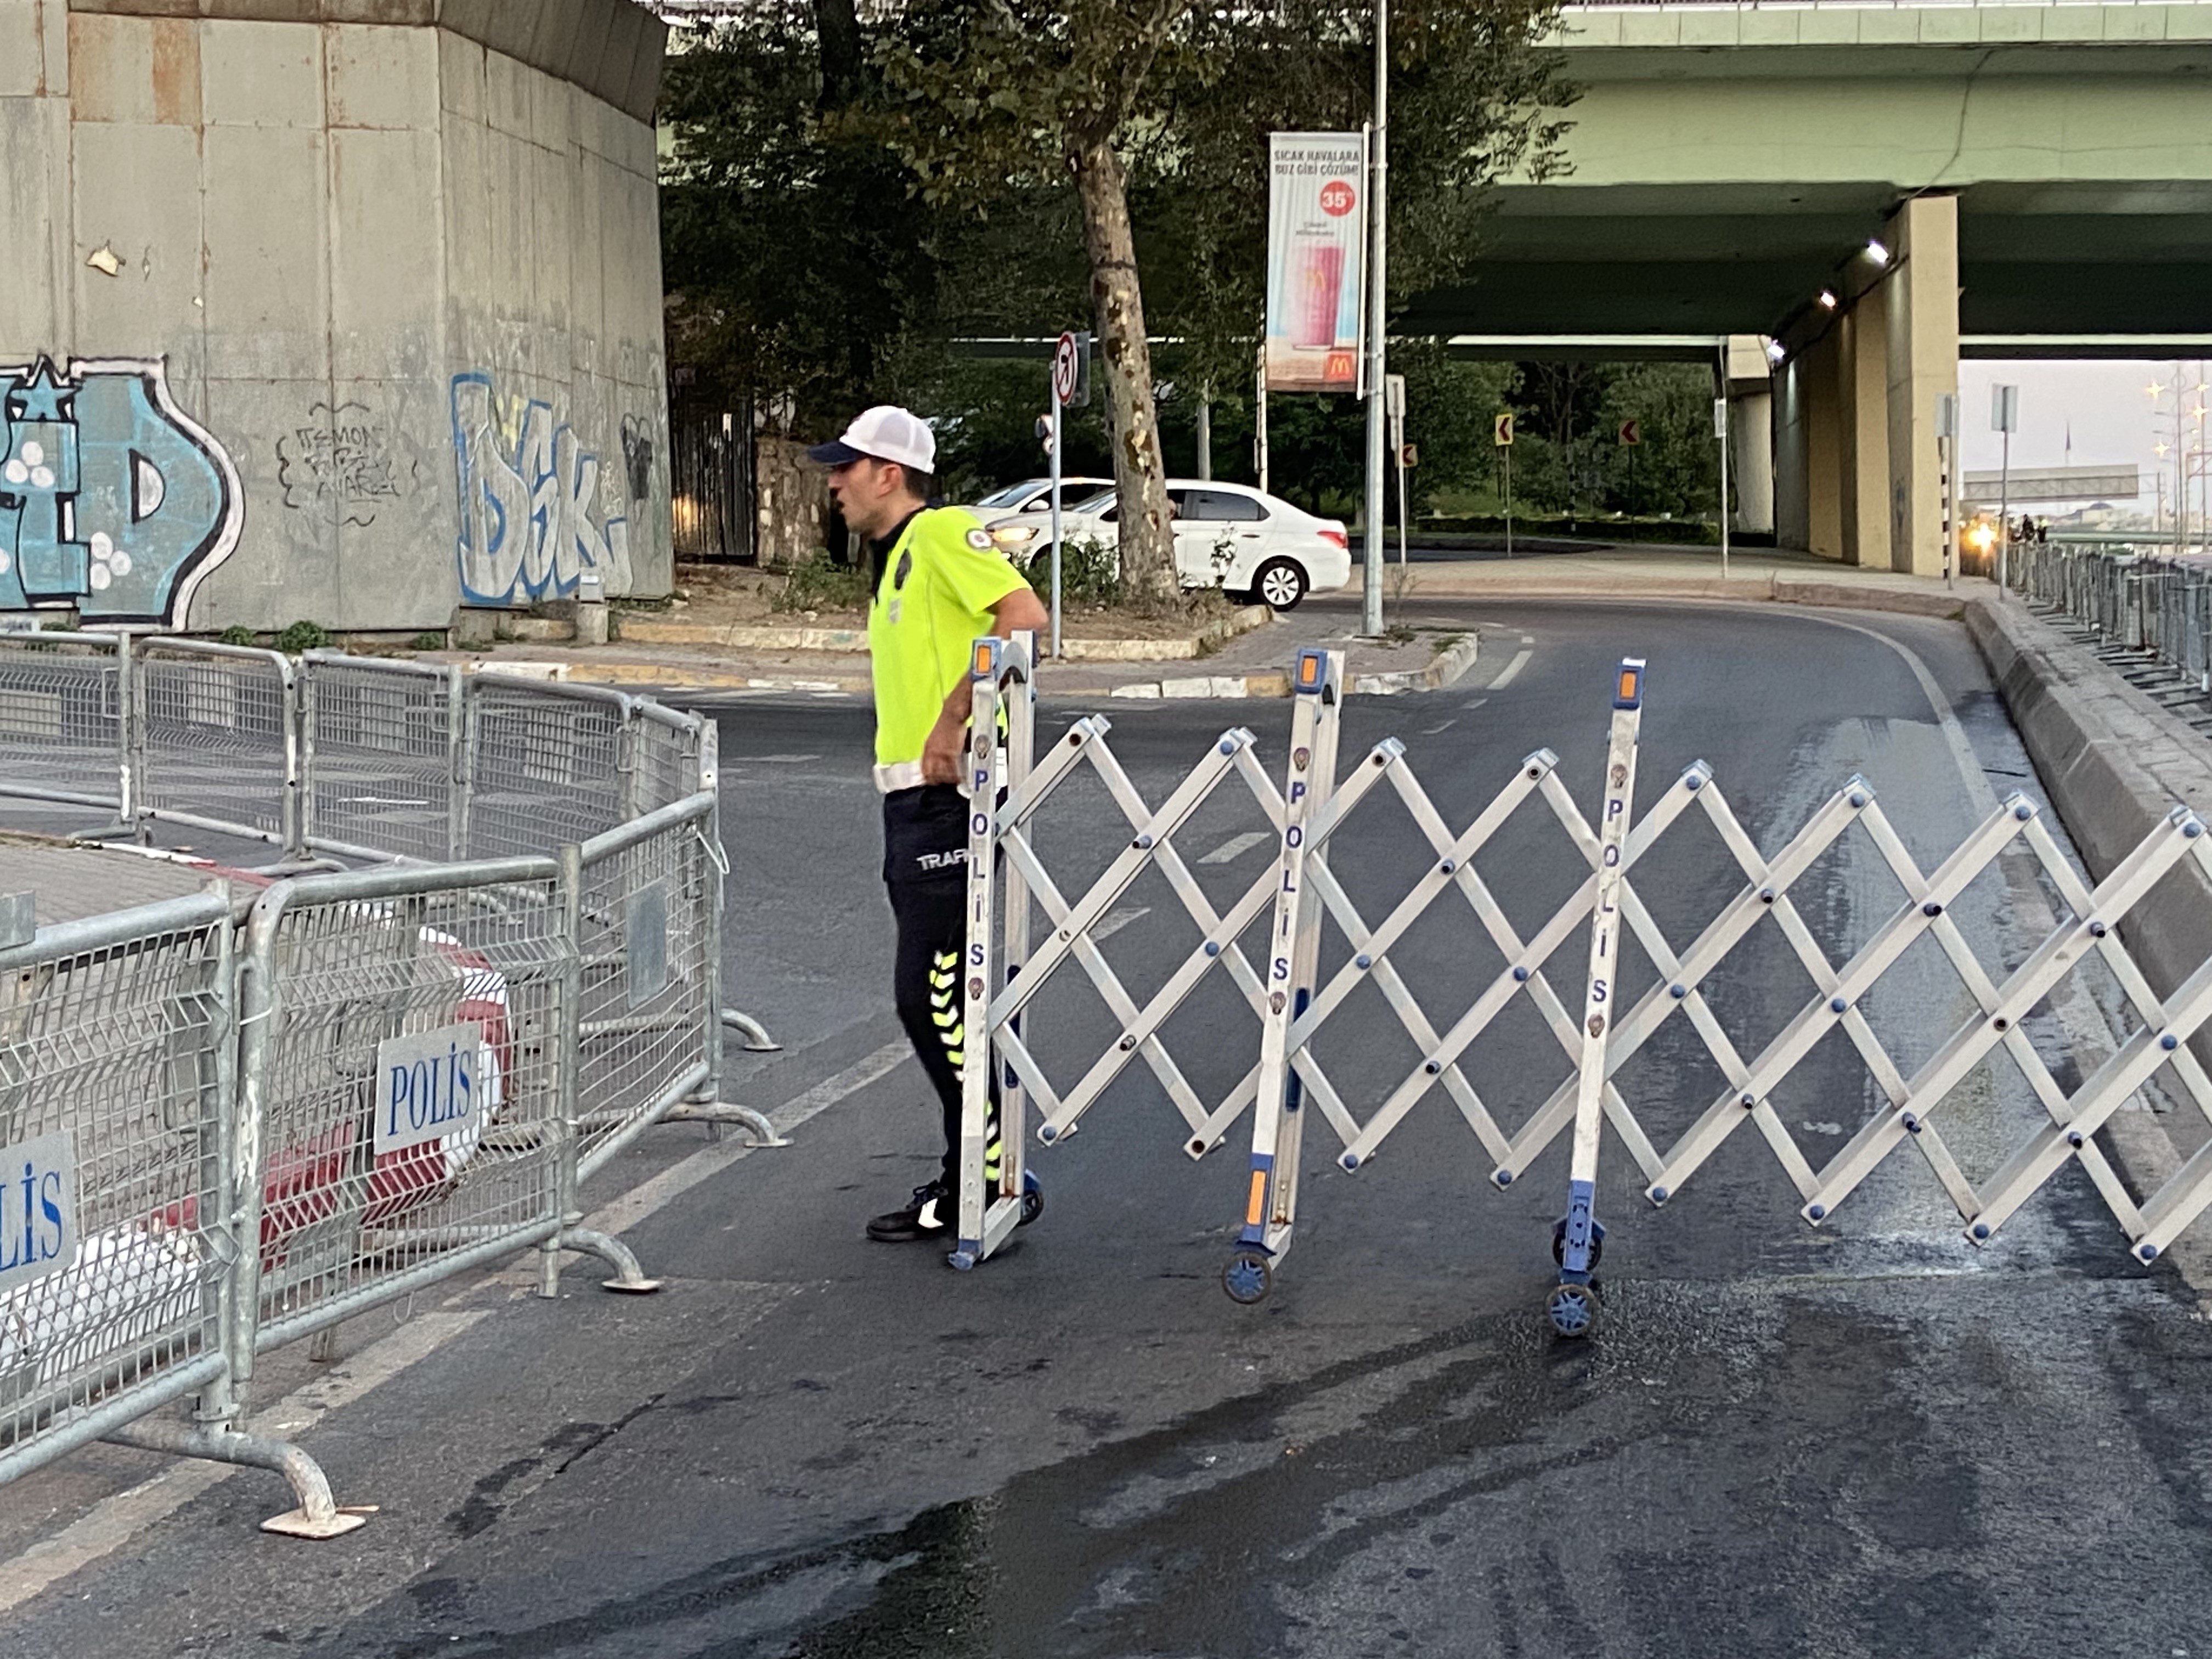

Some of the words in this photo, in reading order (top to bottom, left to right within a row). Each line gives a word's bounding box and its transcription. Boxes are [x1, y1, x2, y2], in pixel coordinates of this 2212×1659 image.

[1274, 150, 1304, 161] SICAK
[1307, 150, 1359, 161] HAVALARA
[1273, 781, 1306, 980] POLİS
[387, 1041, 471, 1136] POLİS
[0, 1162, 62, 1272] LİS
